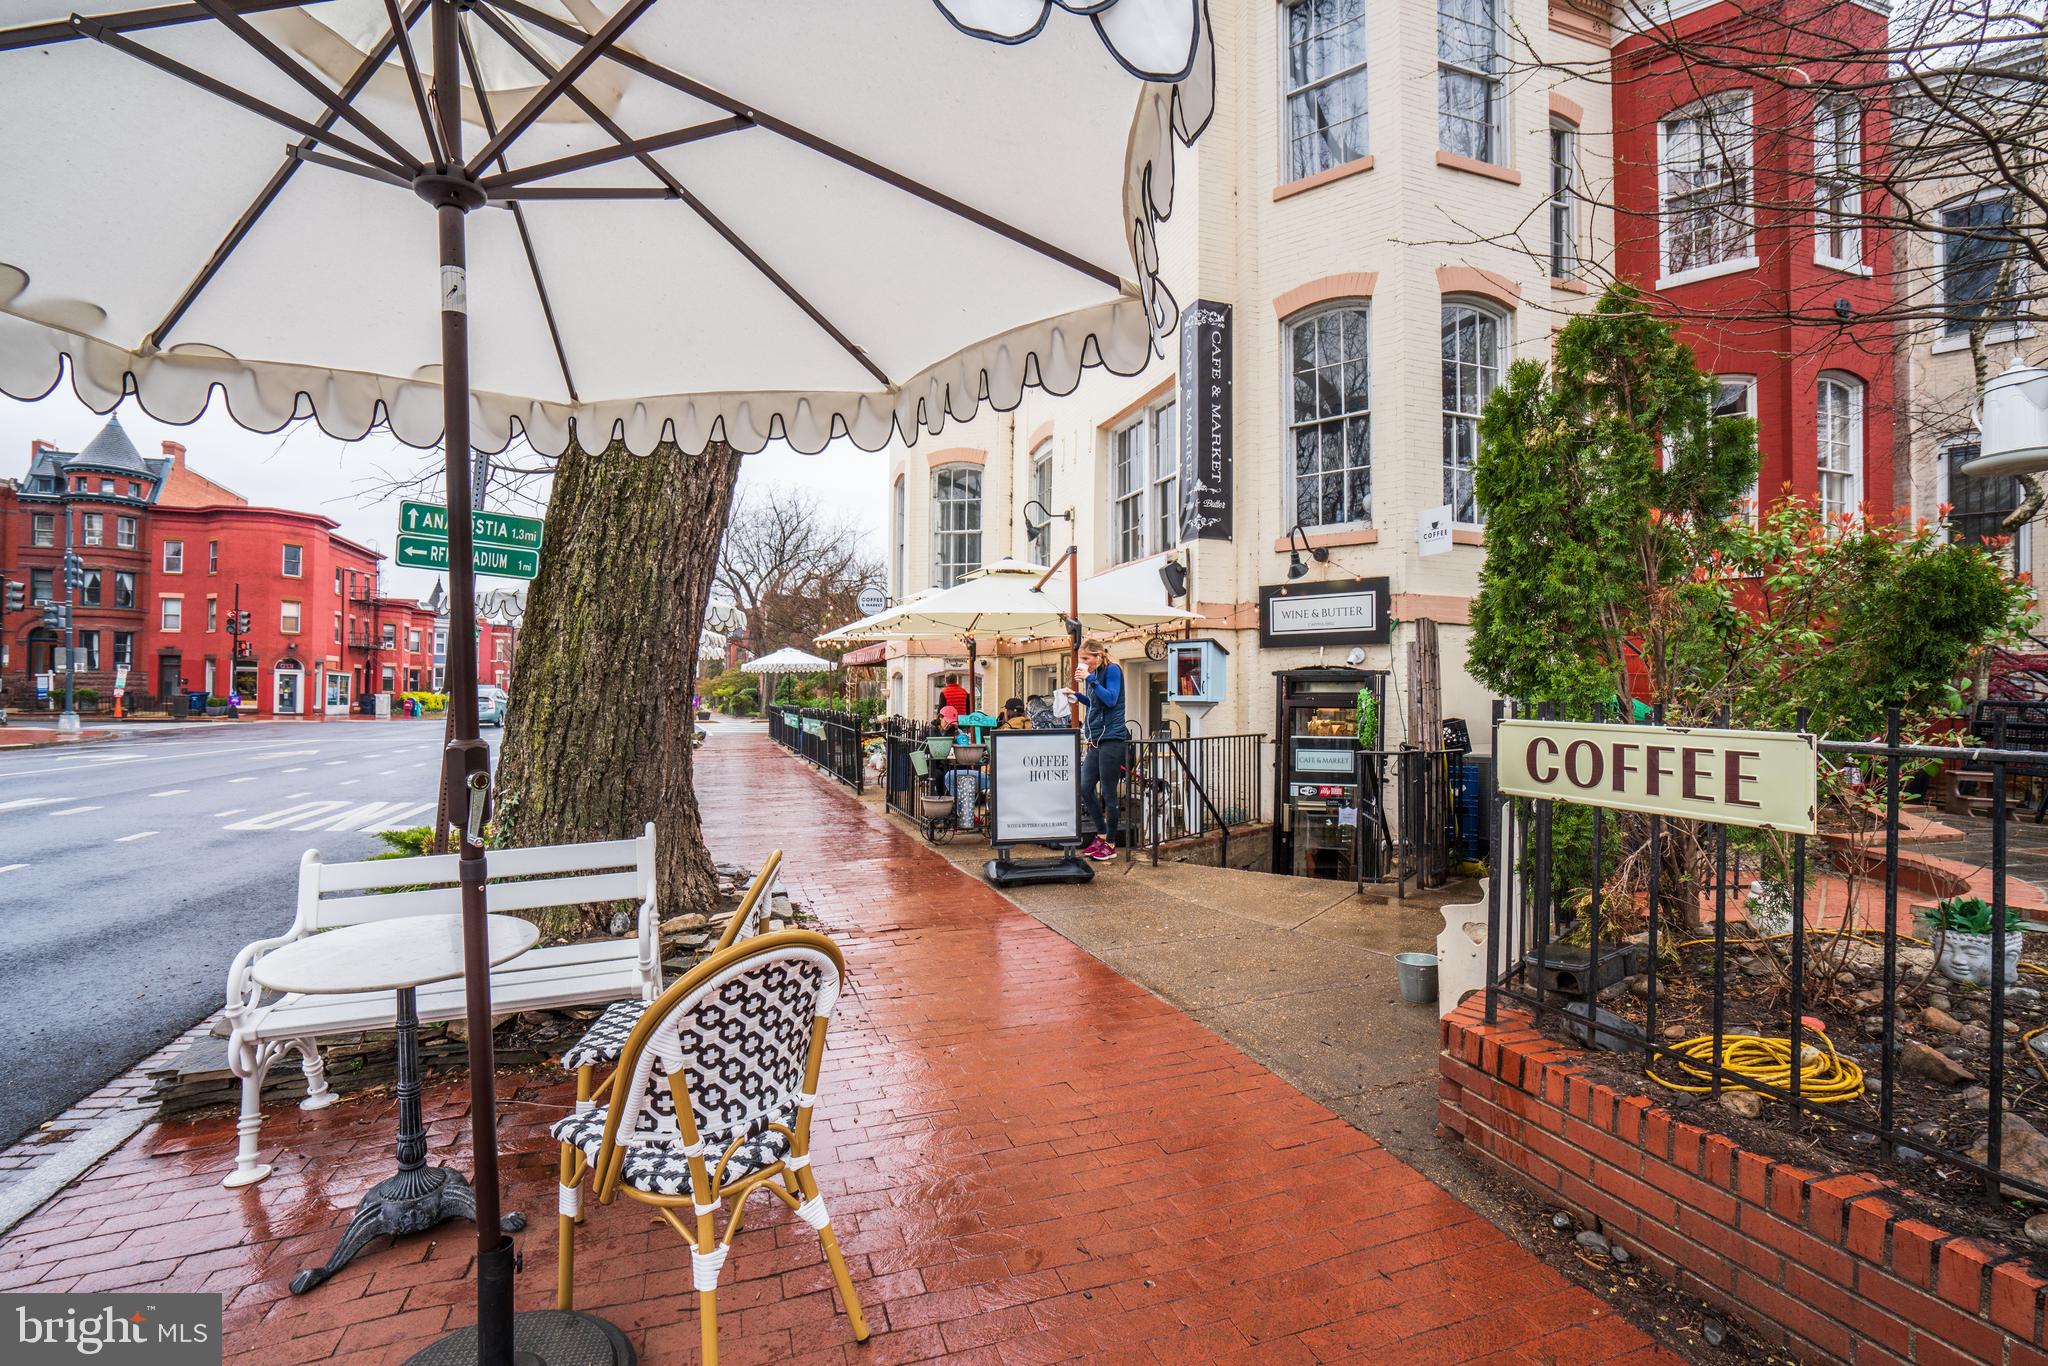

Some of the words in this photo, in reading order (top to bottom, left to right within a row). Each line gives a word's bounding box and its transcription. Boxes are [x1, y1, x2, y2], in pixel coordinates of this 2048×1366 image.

[1211, 331, 1222, 380] CAFE
[1211, 385, 1222, 398] &
[1211, 403, 1222, 483] MARKET
[423, 512, 507, 537] ANSTIA
[1423, 529, 1448, 540] COFFEE
[430, 545, 449, 563] RF
[473, 550, 508, 569] ADIUM
[1281, 608, 1310, 620] WINE
[1311, 608, 1320, 618] &
[1321, 606, 1363, 618] BUTTER
[1023, 755, 1068, 767] COFFEE
[1030, 770, 1068, 782] HOUSE
[1526, 736, 1762, 808] COFFEE
